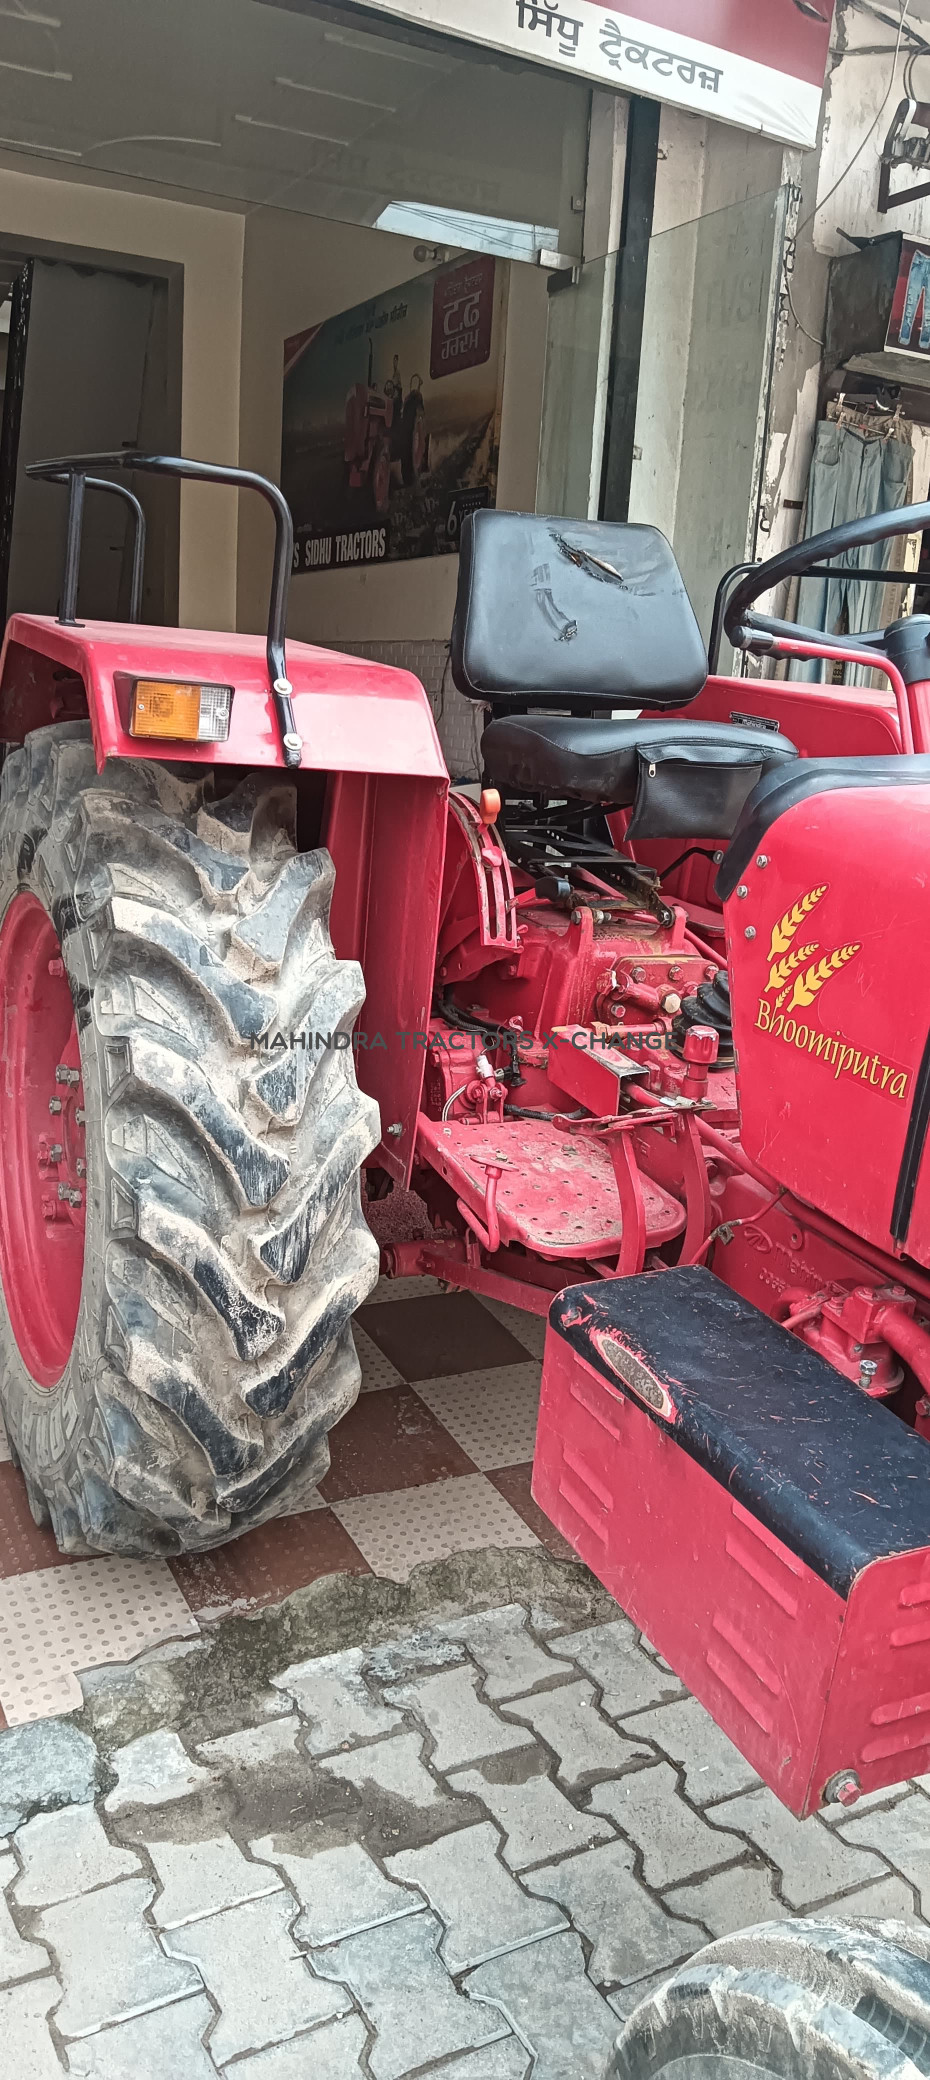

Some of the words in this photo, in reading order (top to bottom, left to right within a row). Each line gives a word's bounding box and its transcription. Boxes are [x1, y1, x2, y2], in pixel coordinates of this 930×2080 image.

[305, 536, 332, 567] SIDHU
[335, 527, 386, 562] TRACTORS
[754, 997, 909, 1099] Bhoomiputra
